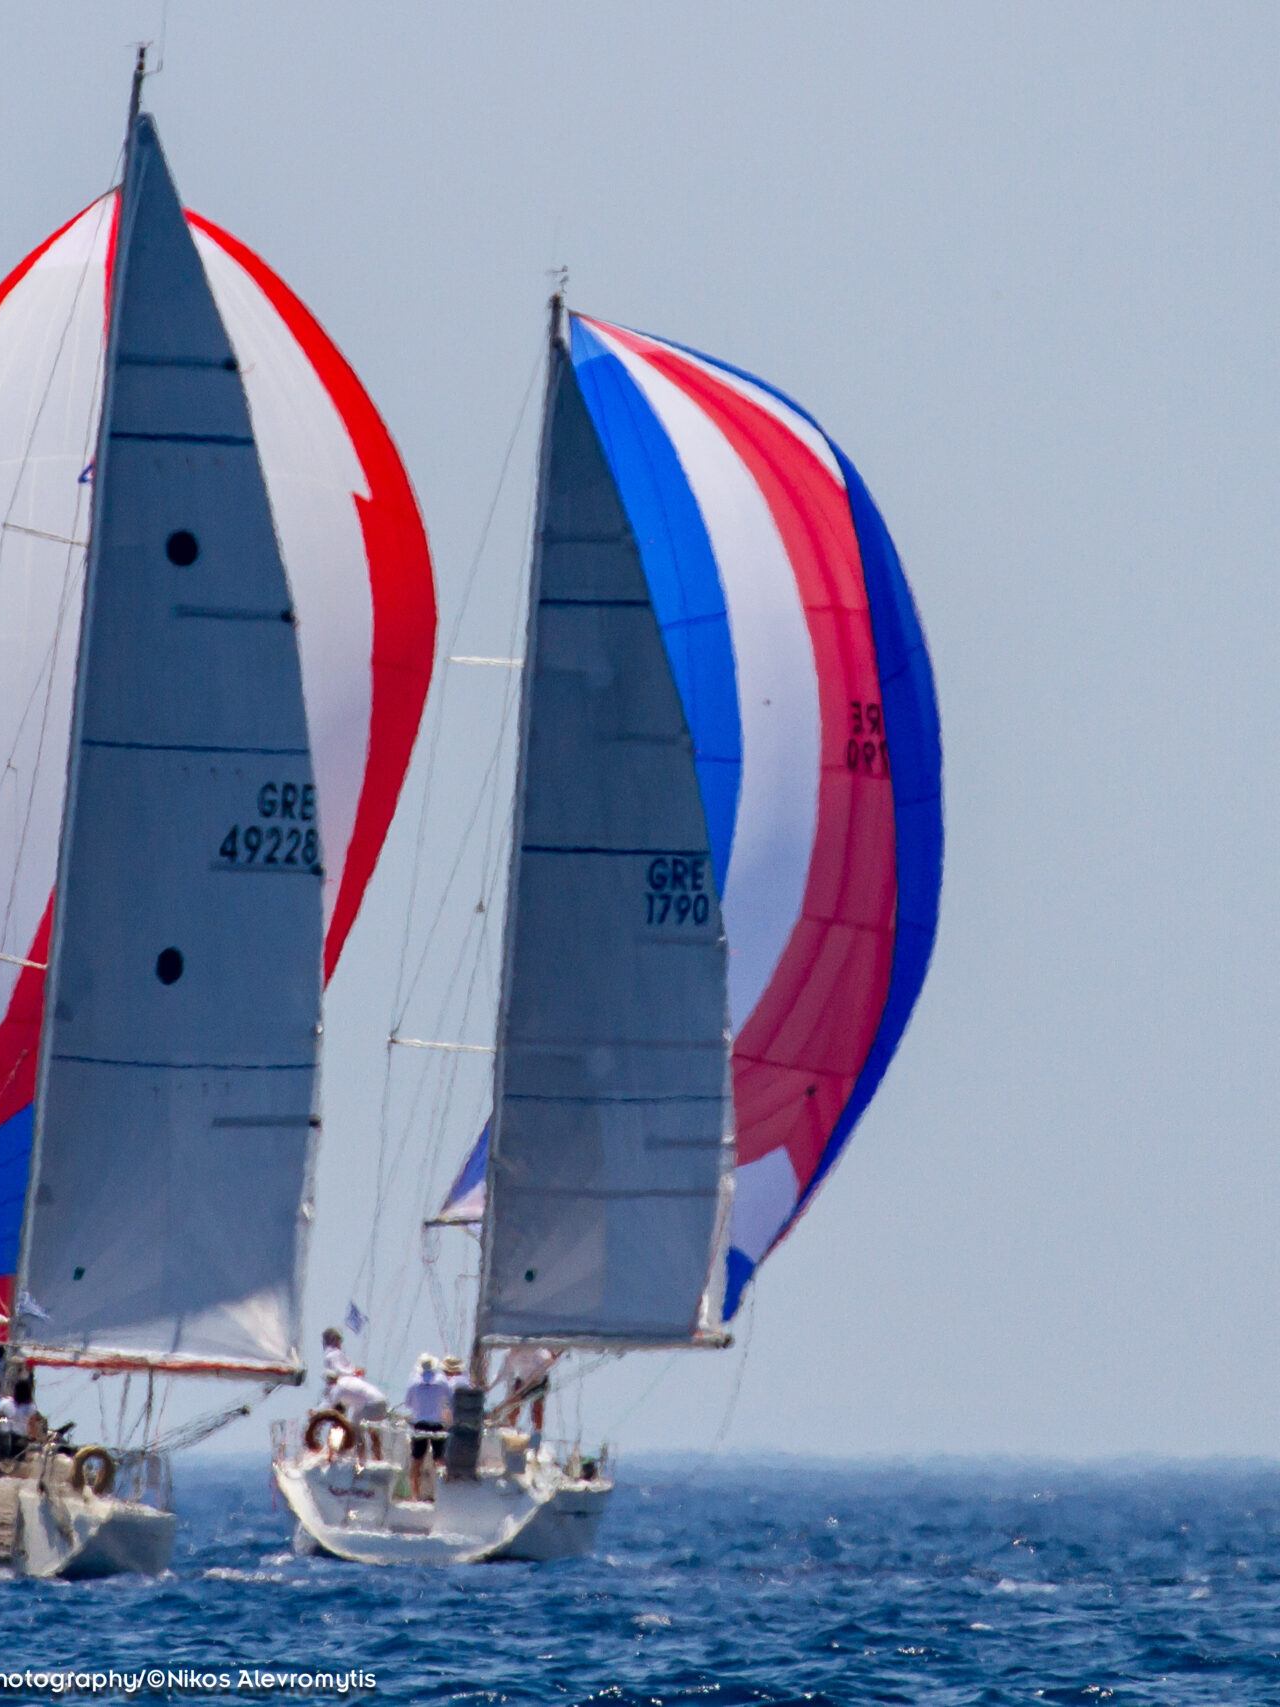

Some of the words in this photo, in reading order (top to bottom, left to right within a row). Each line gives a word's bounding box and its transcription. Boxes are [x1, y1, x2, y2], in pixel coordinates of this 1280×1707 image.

[257, 781, 317, 821] GRE
[219, 824, 319, 864] 49228
[648, 858, 705, 891] GRE
[646, 893, 709, 925] 1790
